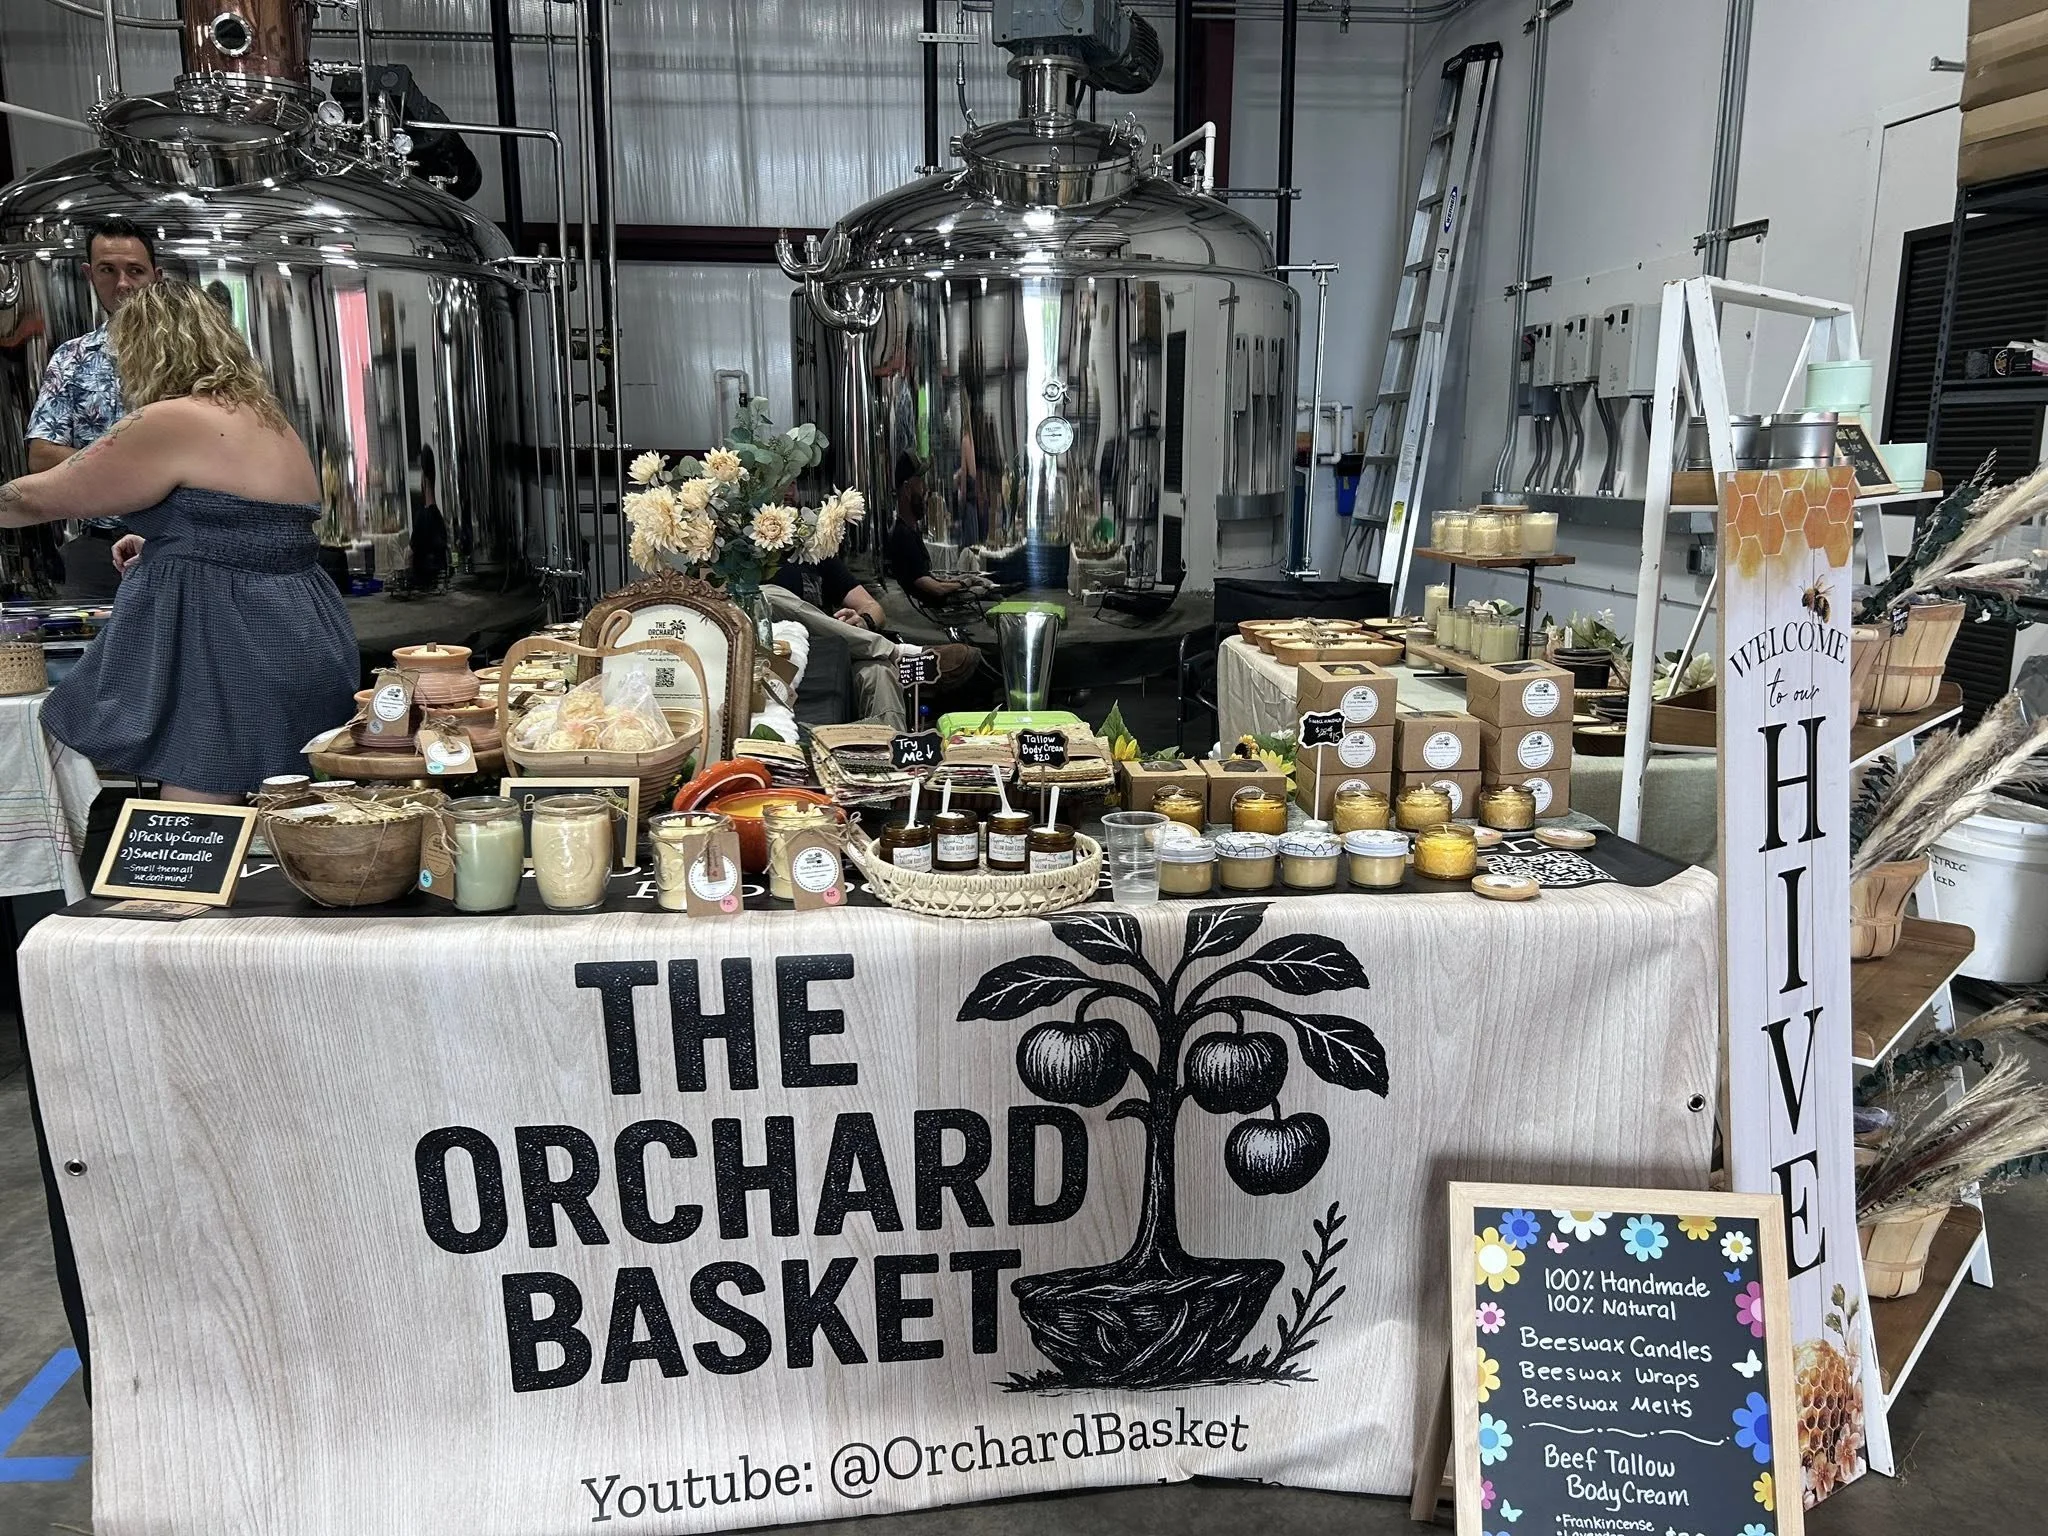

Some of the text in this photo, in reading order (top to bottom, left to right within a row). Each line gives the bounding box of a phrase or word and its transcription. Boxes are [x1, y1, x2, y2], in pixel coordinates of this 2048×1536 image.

[1446, 194, 1456, 223] WERNER
[1728, 621, 1848, 678] WELCOME
[1766, 667, 1820, 708] to our
[895, 738, 919, 751] Try
[1022, 743, 1064, 755] Body Cream
[1023, 734, 1056, 744] Tallow
[148, 814, 195, 827] STEPS:
[165, 832, 181, 846] Up
[182, 831, 224, 844] Candle
[158, 865, 179, 873] them
[170, 849, 213, 862] Candle
[1758, 715, 1827, 1280] HIVE
[574, 953, 859, 1096] THE
[414, 1105, 1090, 1255] ORCHARD
[1544, 1267, 1711, 1298] 100% Handmade
[502, 1250, 1021, 1394] BASKET
[1547, 1293, 1676, 1321] 100% Natural
[1519, 1325, 1713, 1363] Beeswax Candles
[1518, 1360, 1700, 1394] Beeswax Wraps
[1522, 1387, 1693, 1418] Beeswax Melts
[581, 1406, 1250, 1523] Youtube: @OrchardBasket
[1544, 1443, 1676, 1478] Beef Tallow
[1565, 1473, 1690, 1512] Body Cream
[1562, 1514, 1655, 1532] Frankincense
